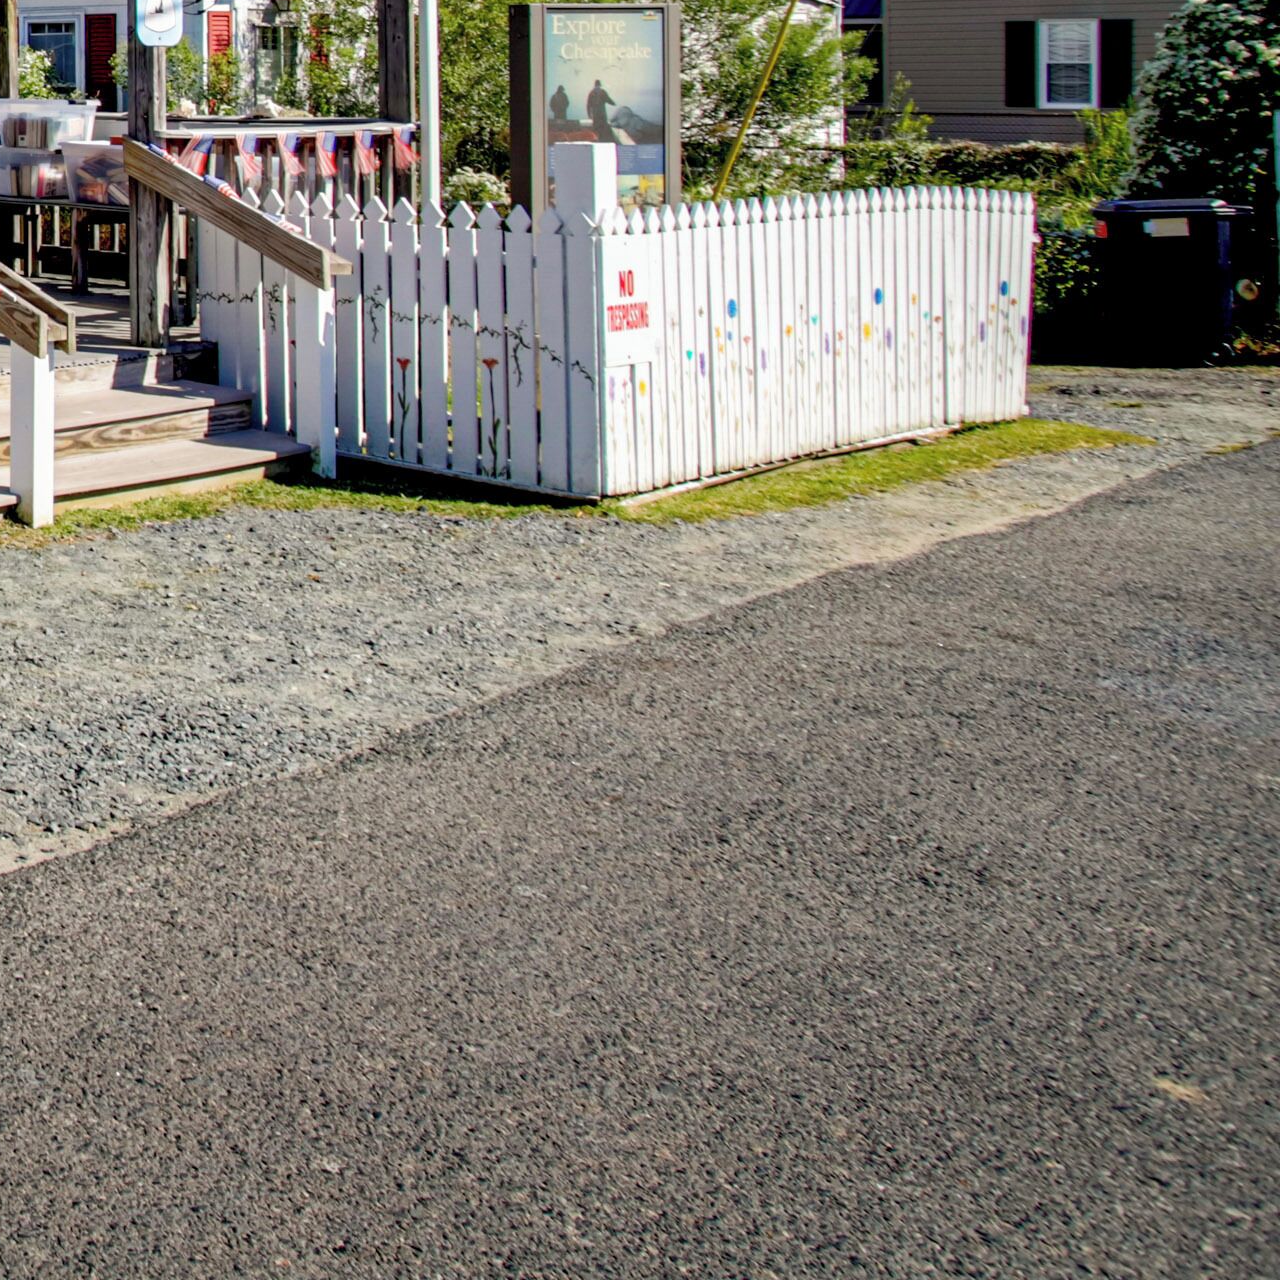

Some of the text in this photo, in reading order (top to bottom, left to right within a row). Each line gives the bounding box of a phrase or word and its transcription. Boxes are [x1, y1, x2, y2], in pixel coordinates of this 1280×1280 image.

[551, 14, 627, 41] Explore
[560, 41, 653, 65] Chesapeake
[618, 269, 634, 298] NO
[607, 301, 649, 333] TRESPASSING
